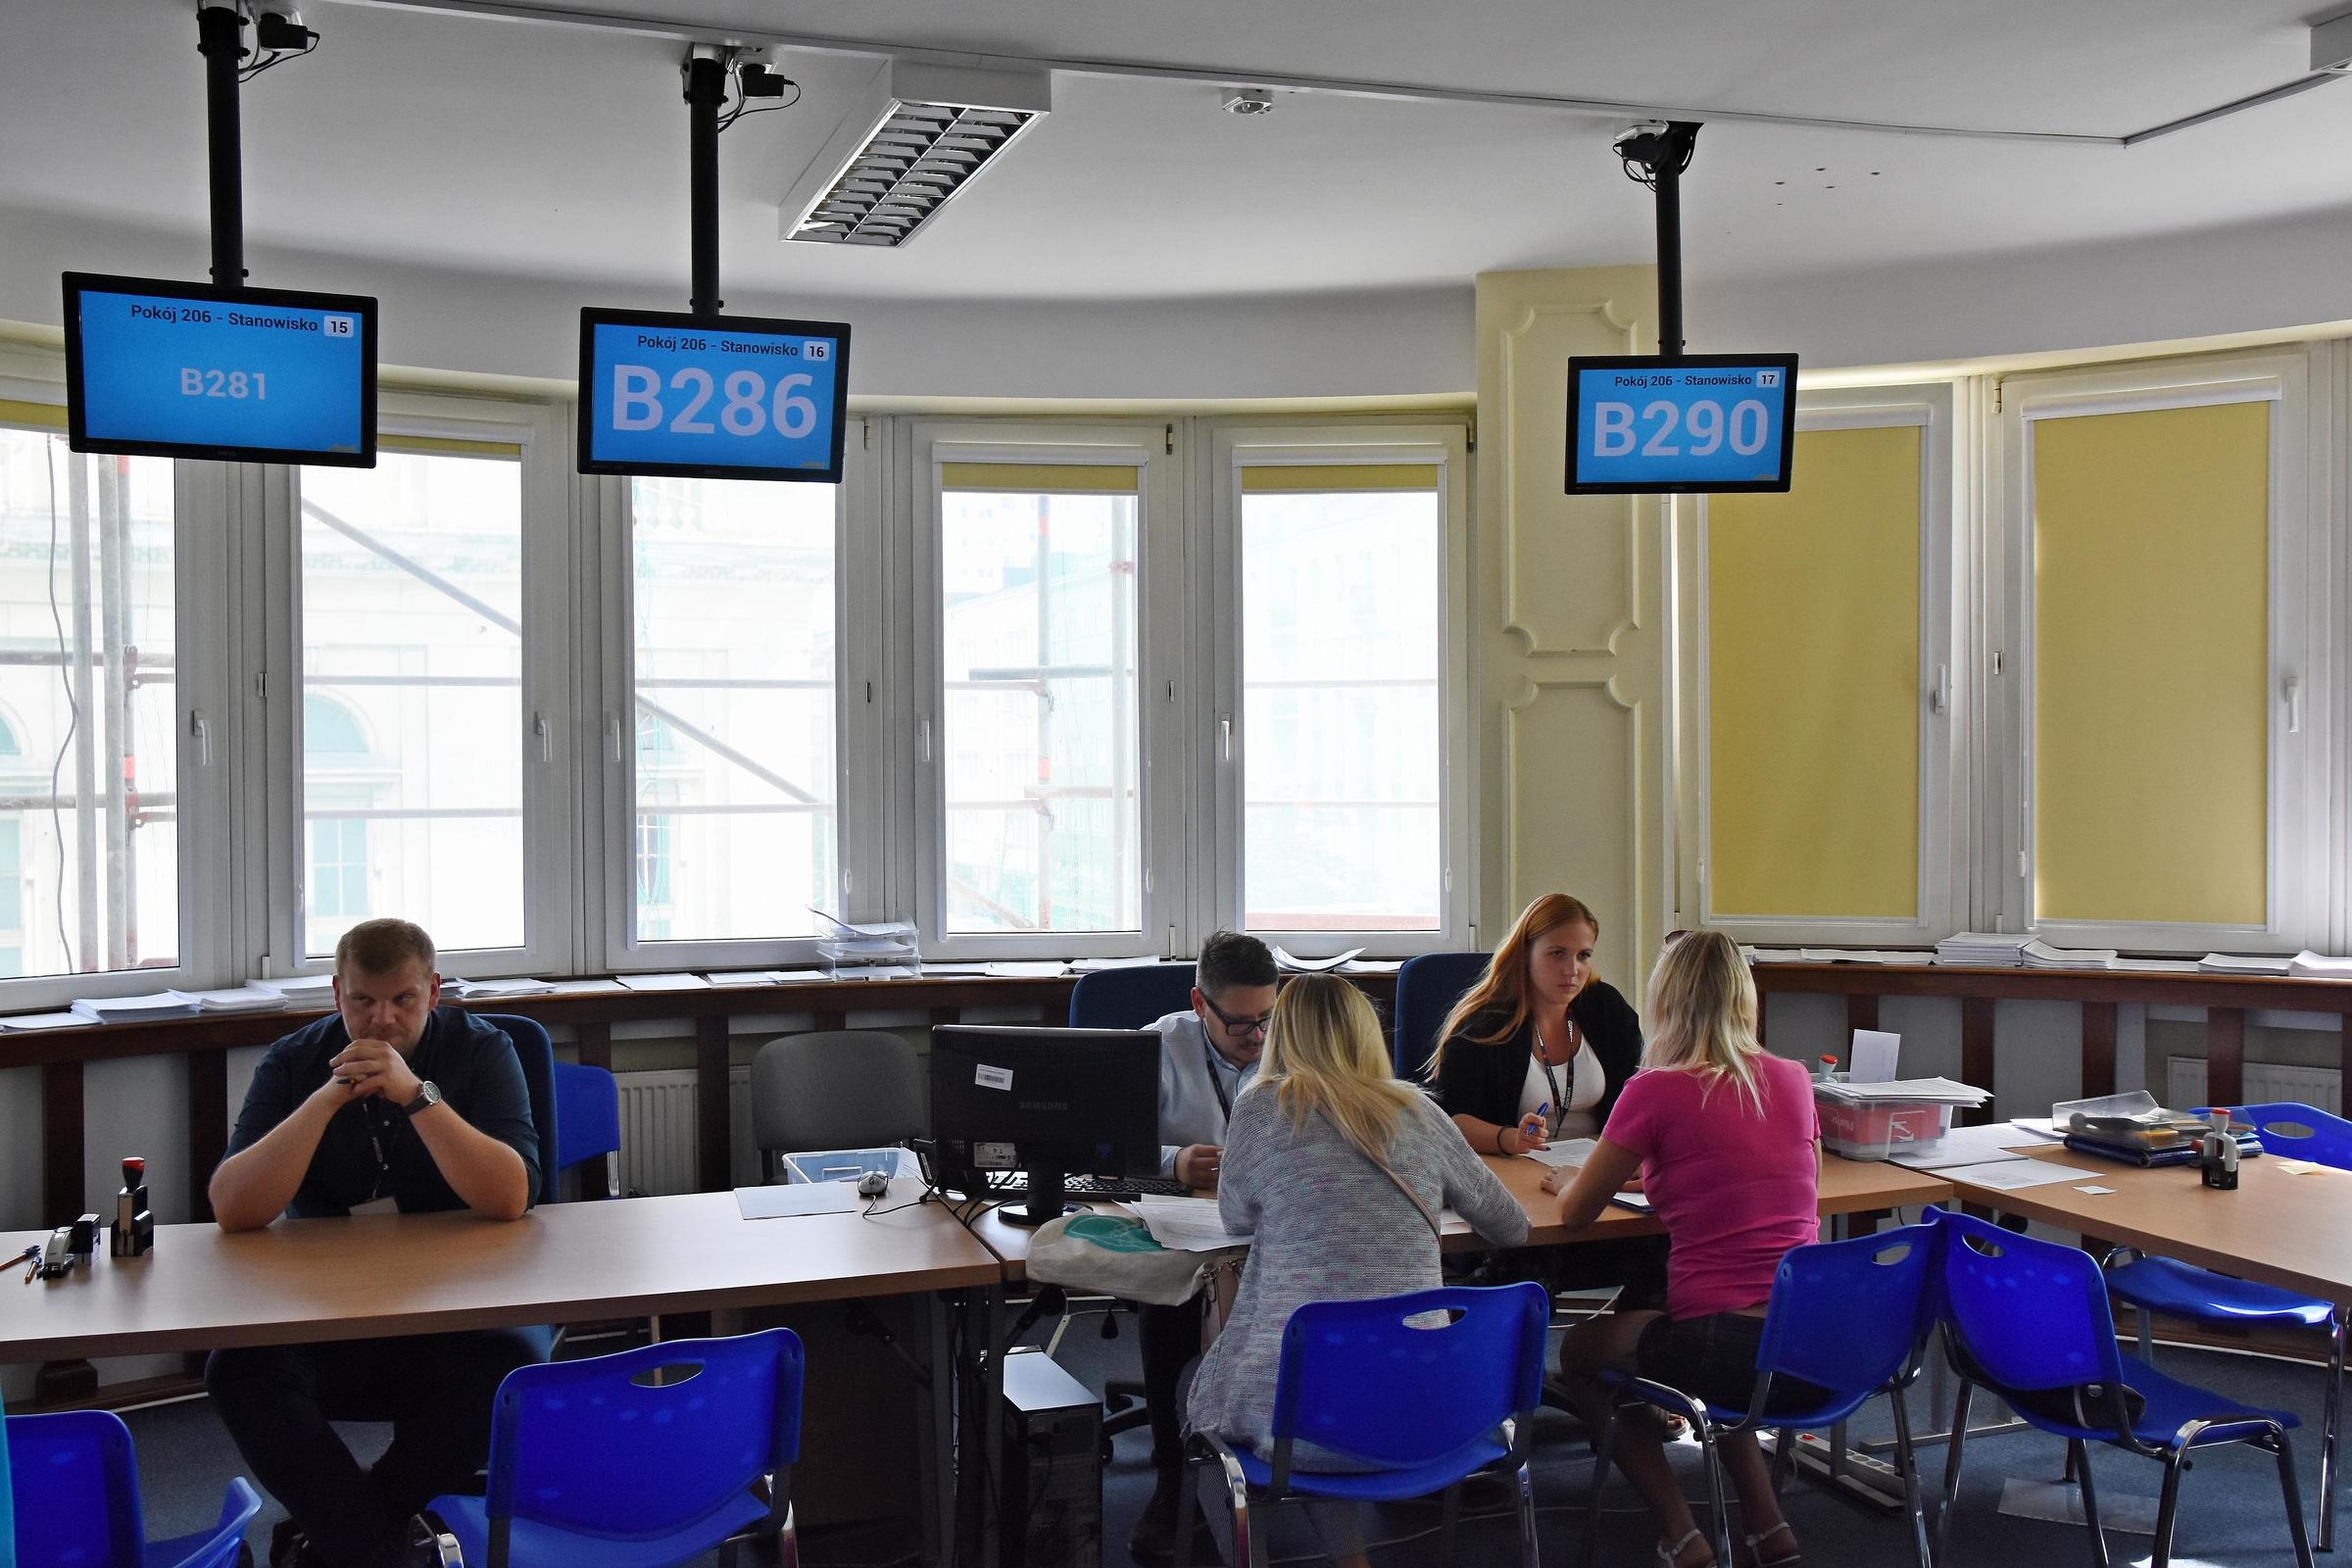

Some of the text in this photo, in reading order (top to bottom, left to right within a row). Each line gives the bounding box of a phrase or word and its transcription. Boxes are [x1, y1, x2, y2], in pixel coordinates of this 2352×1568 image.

[130, 304, 176, 323] Pokój
[181, 308, 212, 323] 206
[228, 312, 318, 331] Stanowisko
[330, 320, 349, 334] 15
[637, 335, 677, 352] Pokój
[680, 337, 707, 351] 206
[720, 340, 799, 357] Stanowisko
[808, 345, 825, 358] 16
[180, 368, 267, 401] B281
[1614, 375, 1647, 389] Pokój
[1650, 375, 1673, 386] 206
[1685, 373, 1752, 386] Stanowisko
[1761, 374, 1776, 385] 17
[612, 365, 817, 439] B286
[1593, 399, 1769, 457] B290
